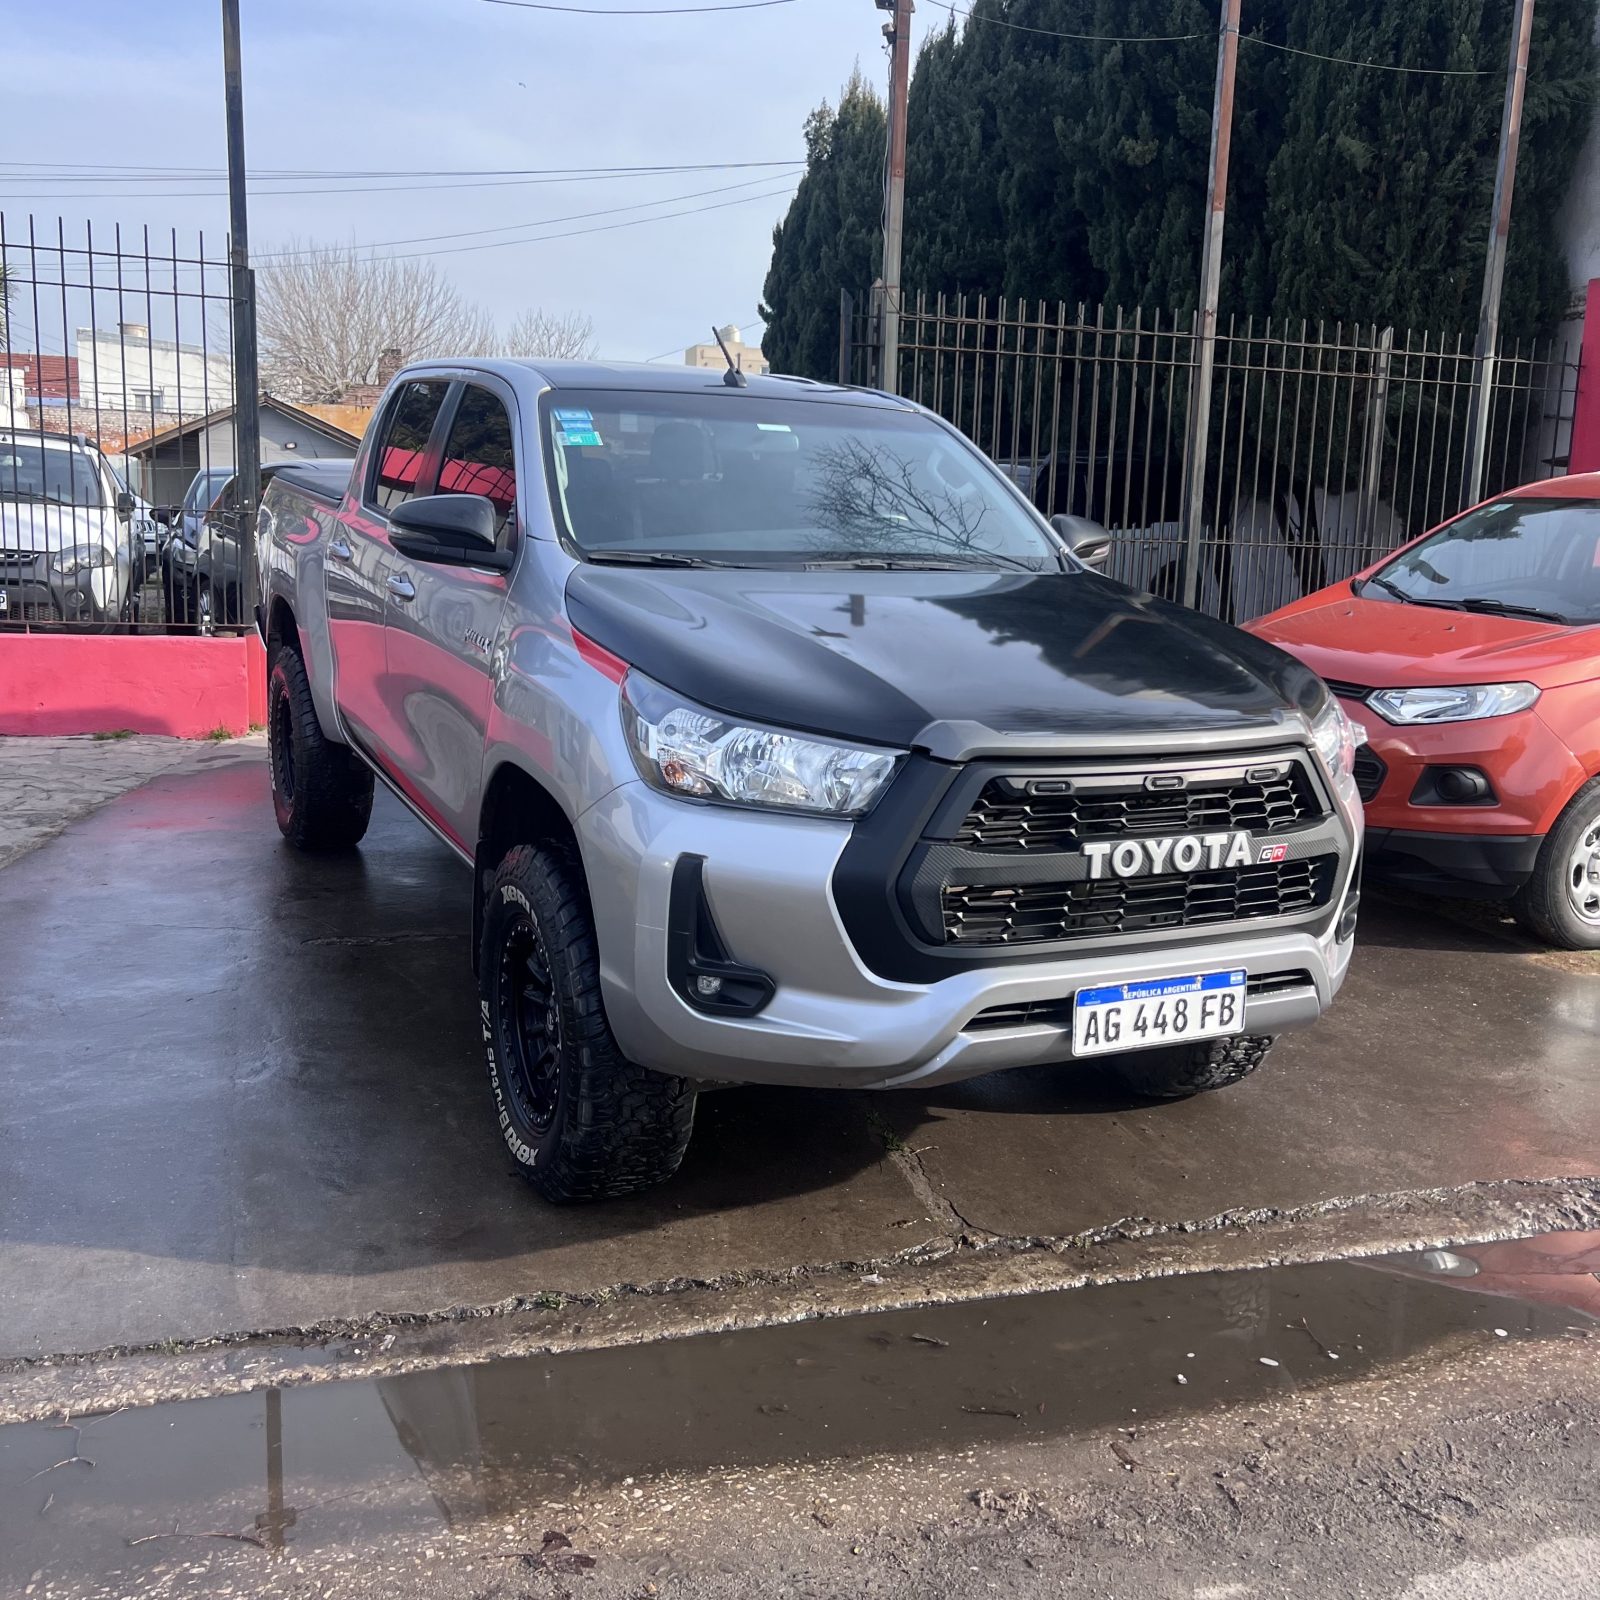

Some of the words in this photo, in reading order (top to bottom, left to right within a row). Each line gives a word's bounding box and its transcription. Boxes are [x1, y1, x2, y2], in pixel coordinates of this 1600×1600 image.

[1083, 832, 1253, 879] TOYOTA
[1259, 846, 1287, 862] GR
[1123, 988, 1162, 1000] REPÚBLICA
[1163, 983, 1202, 995] ARGENTINA
[1083, 1007, 1121, 1046] AG
[1133, 998, 1189, 1038] 448
[1200, 992, 1236, 1030] FB
[503, 1126, 539, 1166] XBRI
